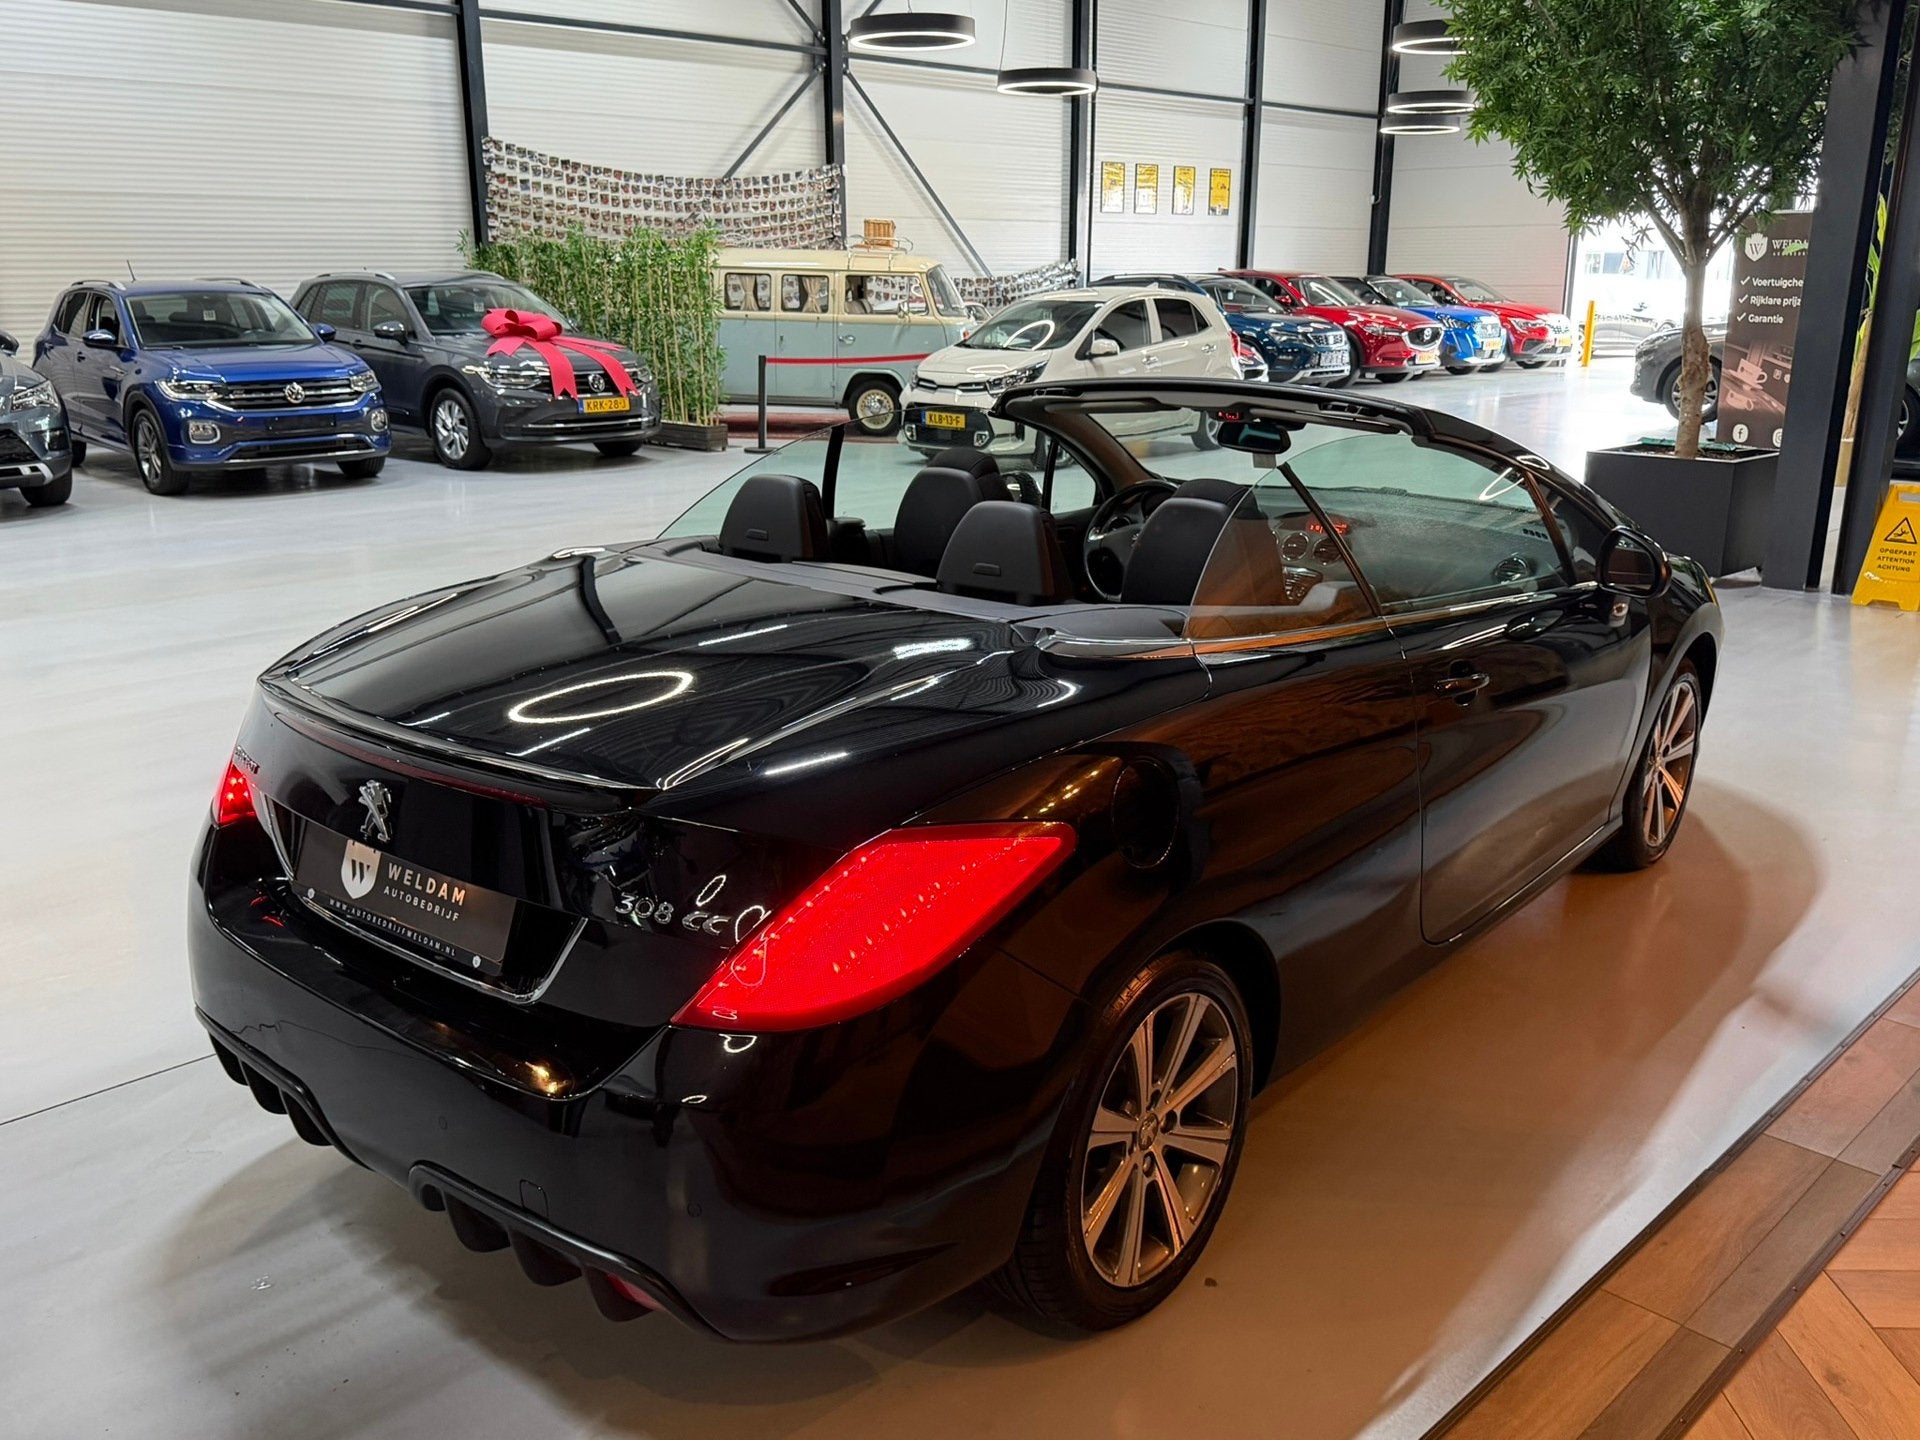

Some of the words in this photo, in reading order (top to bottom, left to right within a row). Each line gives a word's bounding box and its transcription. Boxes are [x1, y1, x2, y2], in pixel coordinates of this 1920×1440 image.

[1750, 296, 1782, 307] Rijklare
[1748, 314, 1784, 323] Garantie
[1879, 547, 1917, 557] OPGEPAST
[1877, 556, 1915, 565] ATTENTION
[1877, 564, 1911, 572] ACHTUNG
[388, 862, 467, 906] WELDAM
[384, 885, 461, 922] AUTOBEDRIJF
[615, 891, 675, 925] 308
[329, 898, 456, 957] WWW.AUTOBEDRIJFWELDAM.NL
